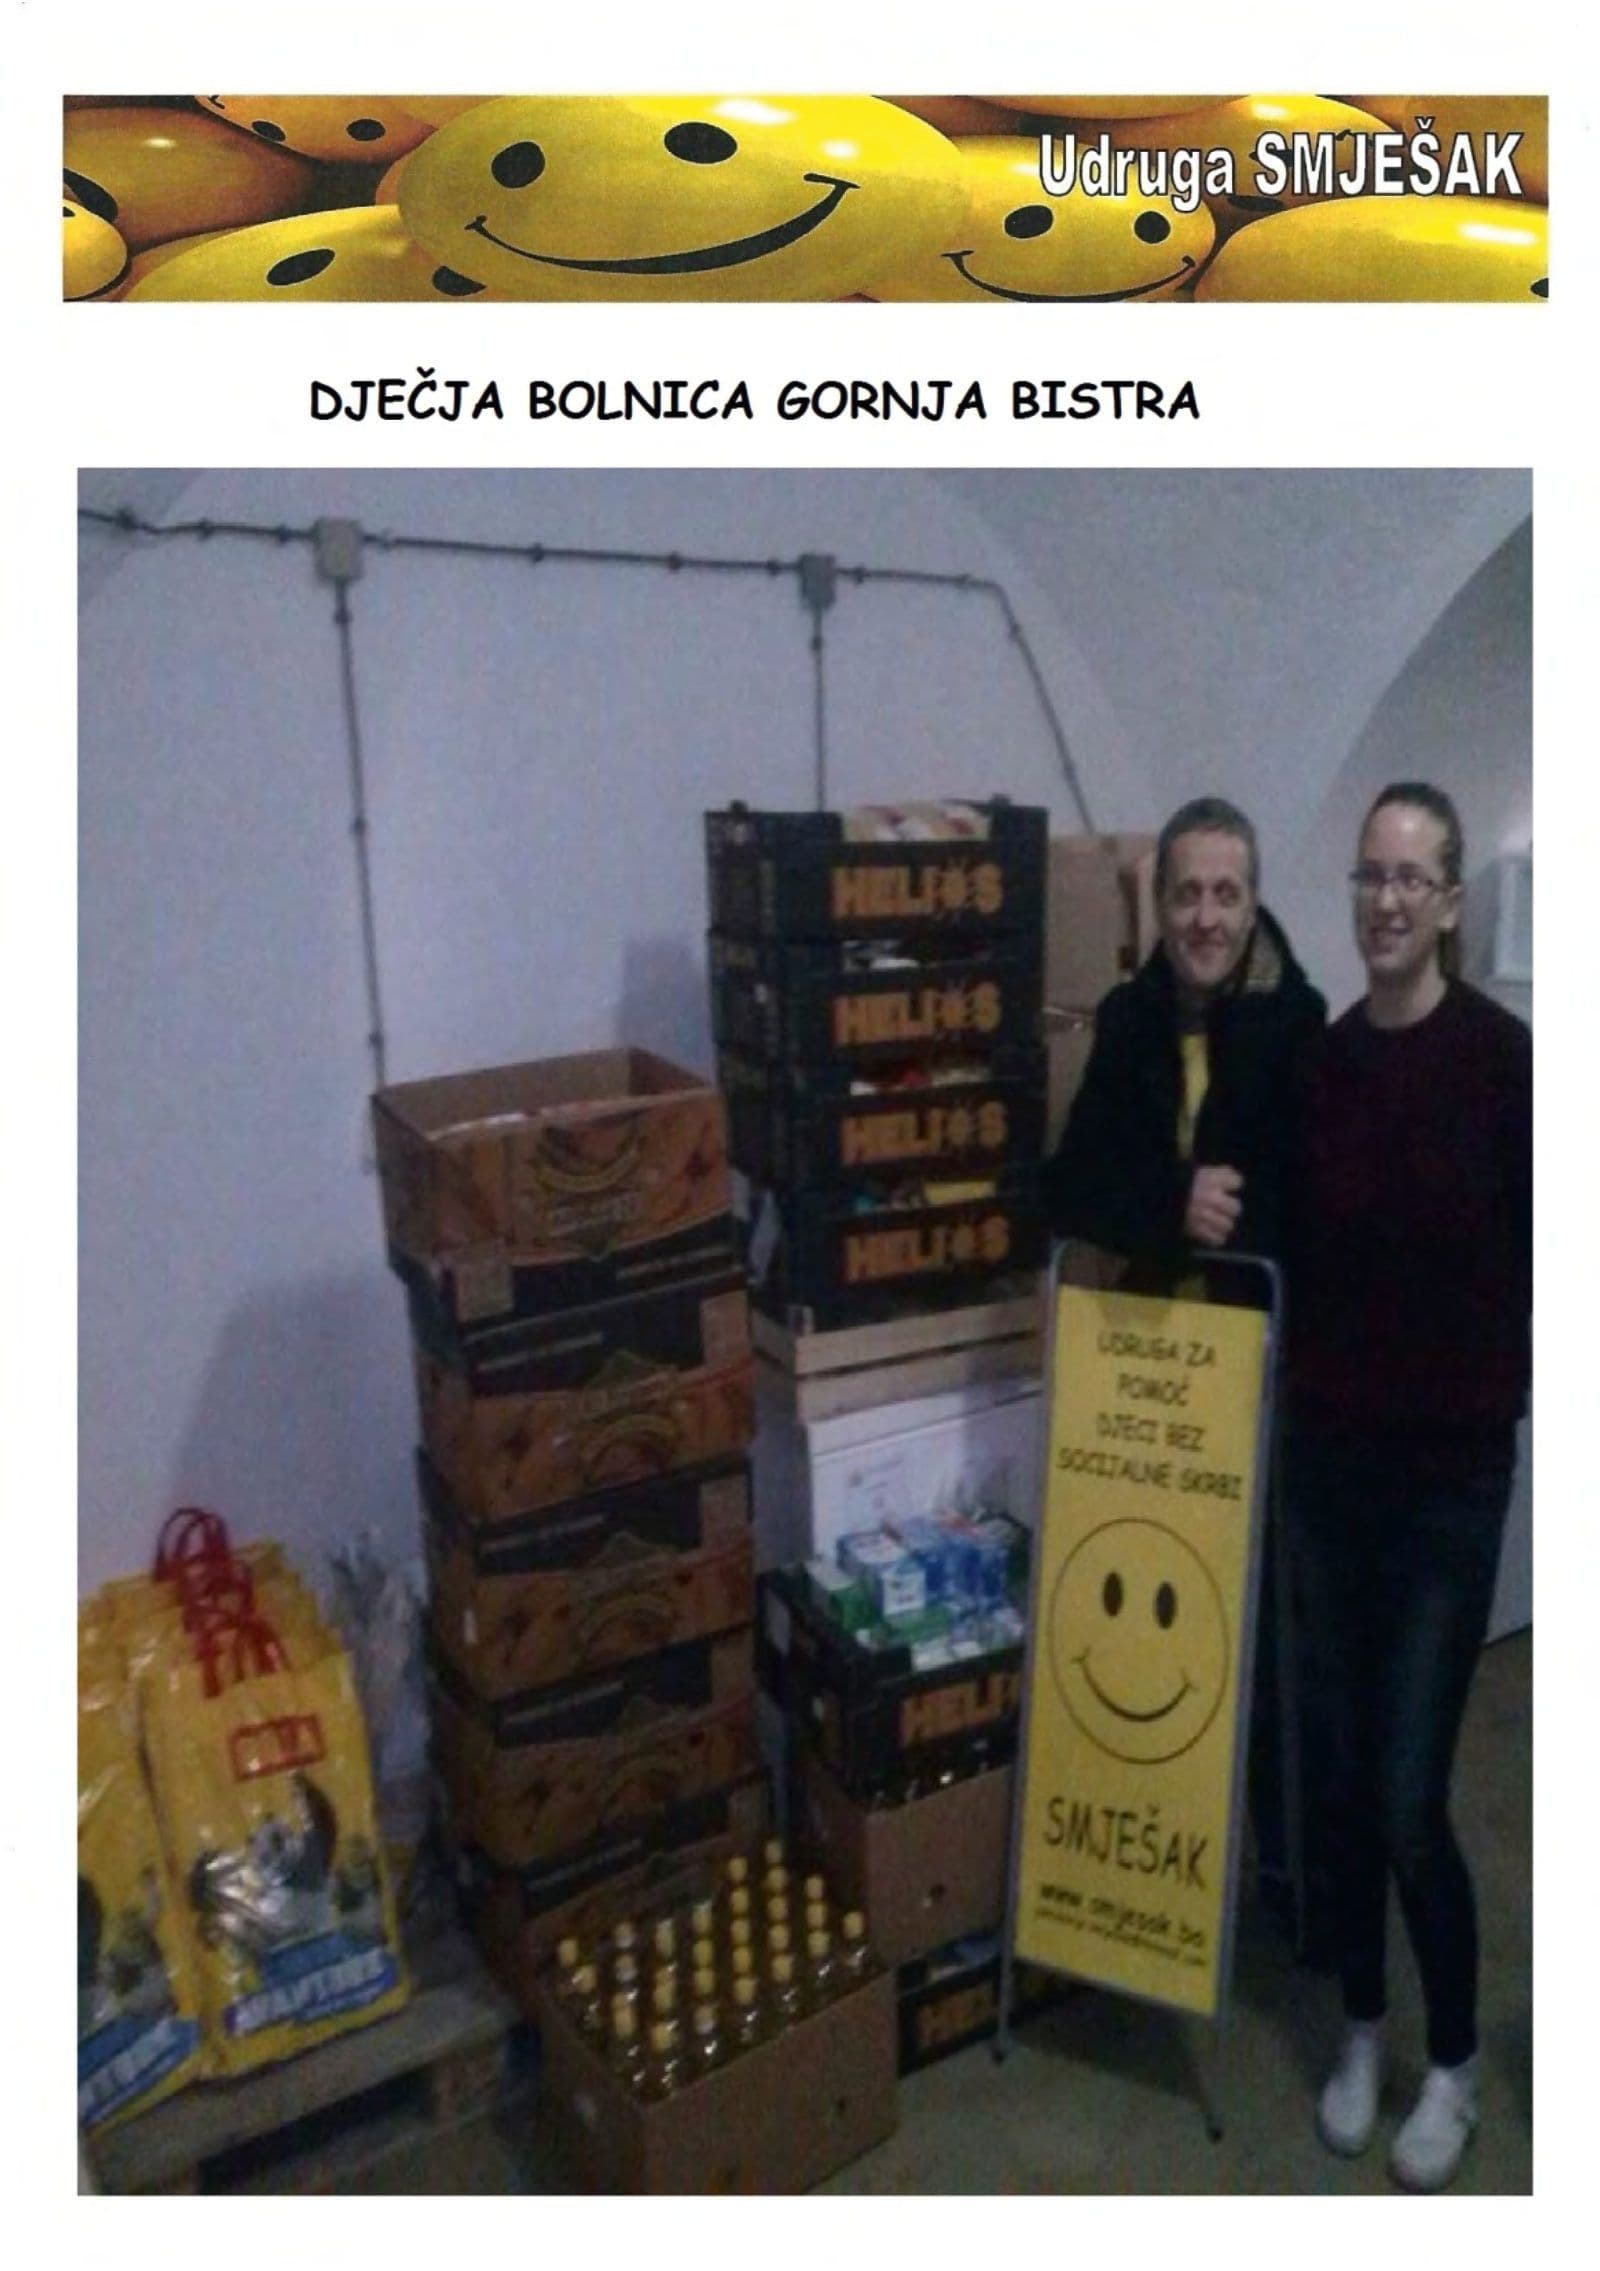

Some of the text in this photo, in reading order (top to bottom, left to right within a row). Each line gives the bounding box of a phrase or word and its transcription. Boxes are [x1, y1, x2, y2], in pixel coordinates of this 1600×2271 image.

[1187, 1341, 1216, 1367] ZA
[1165, 1422, 1207, 1452] BEZ
[1043, 1796, 1208, 1891] SMJEŠAK
